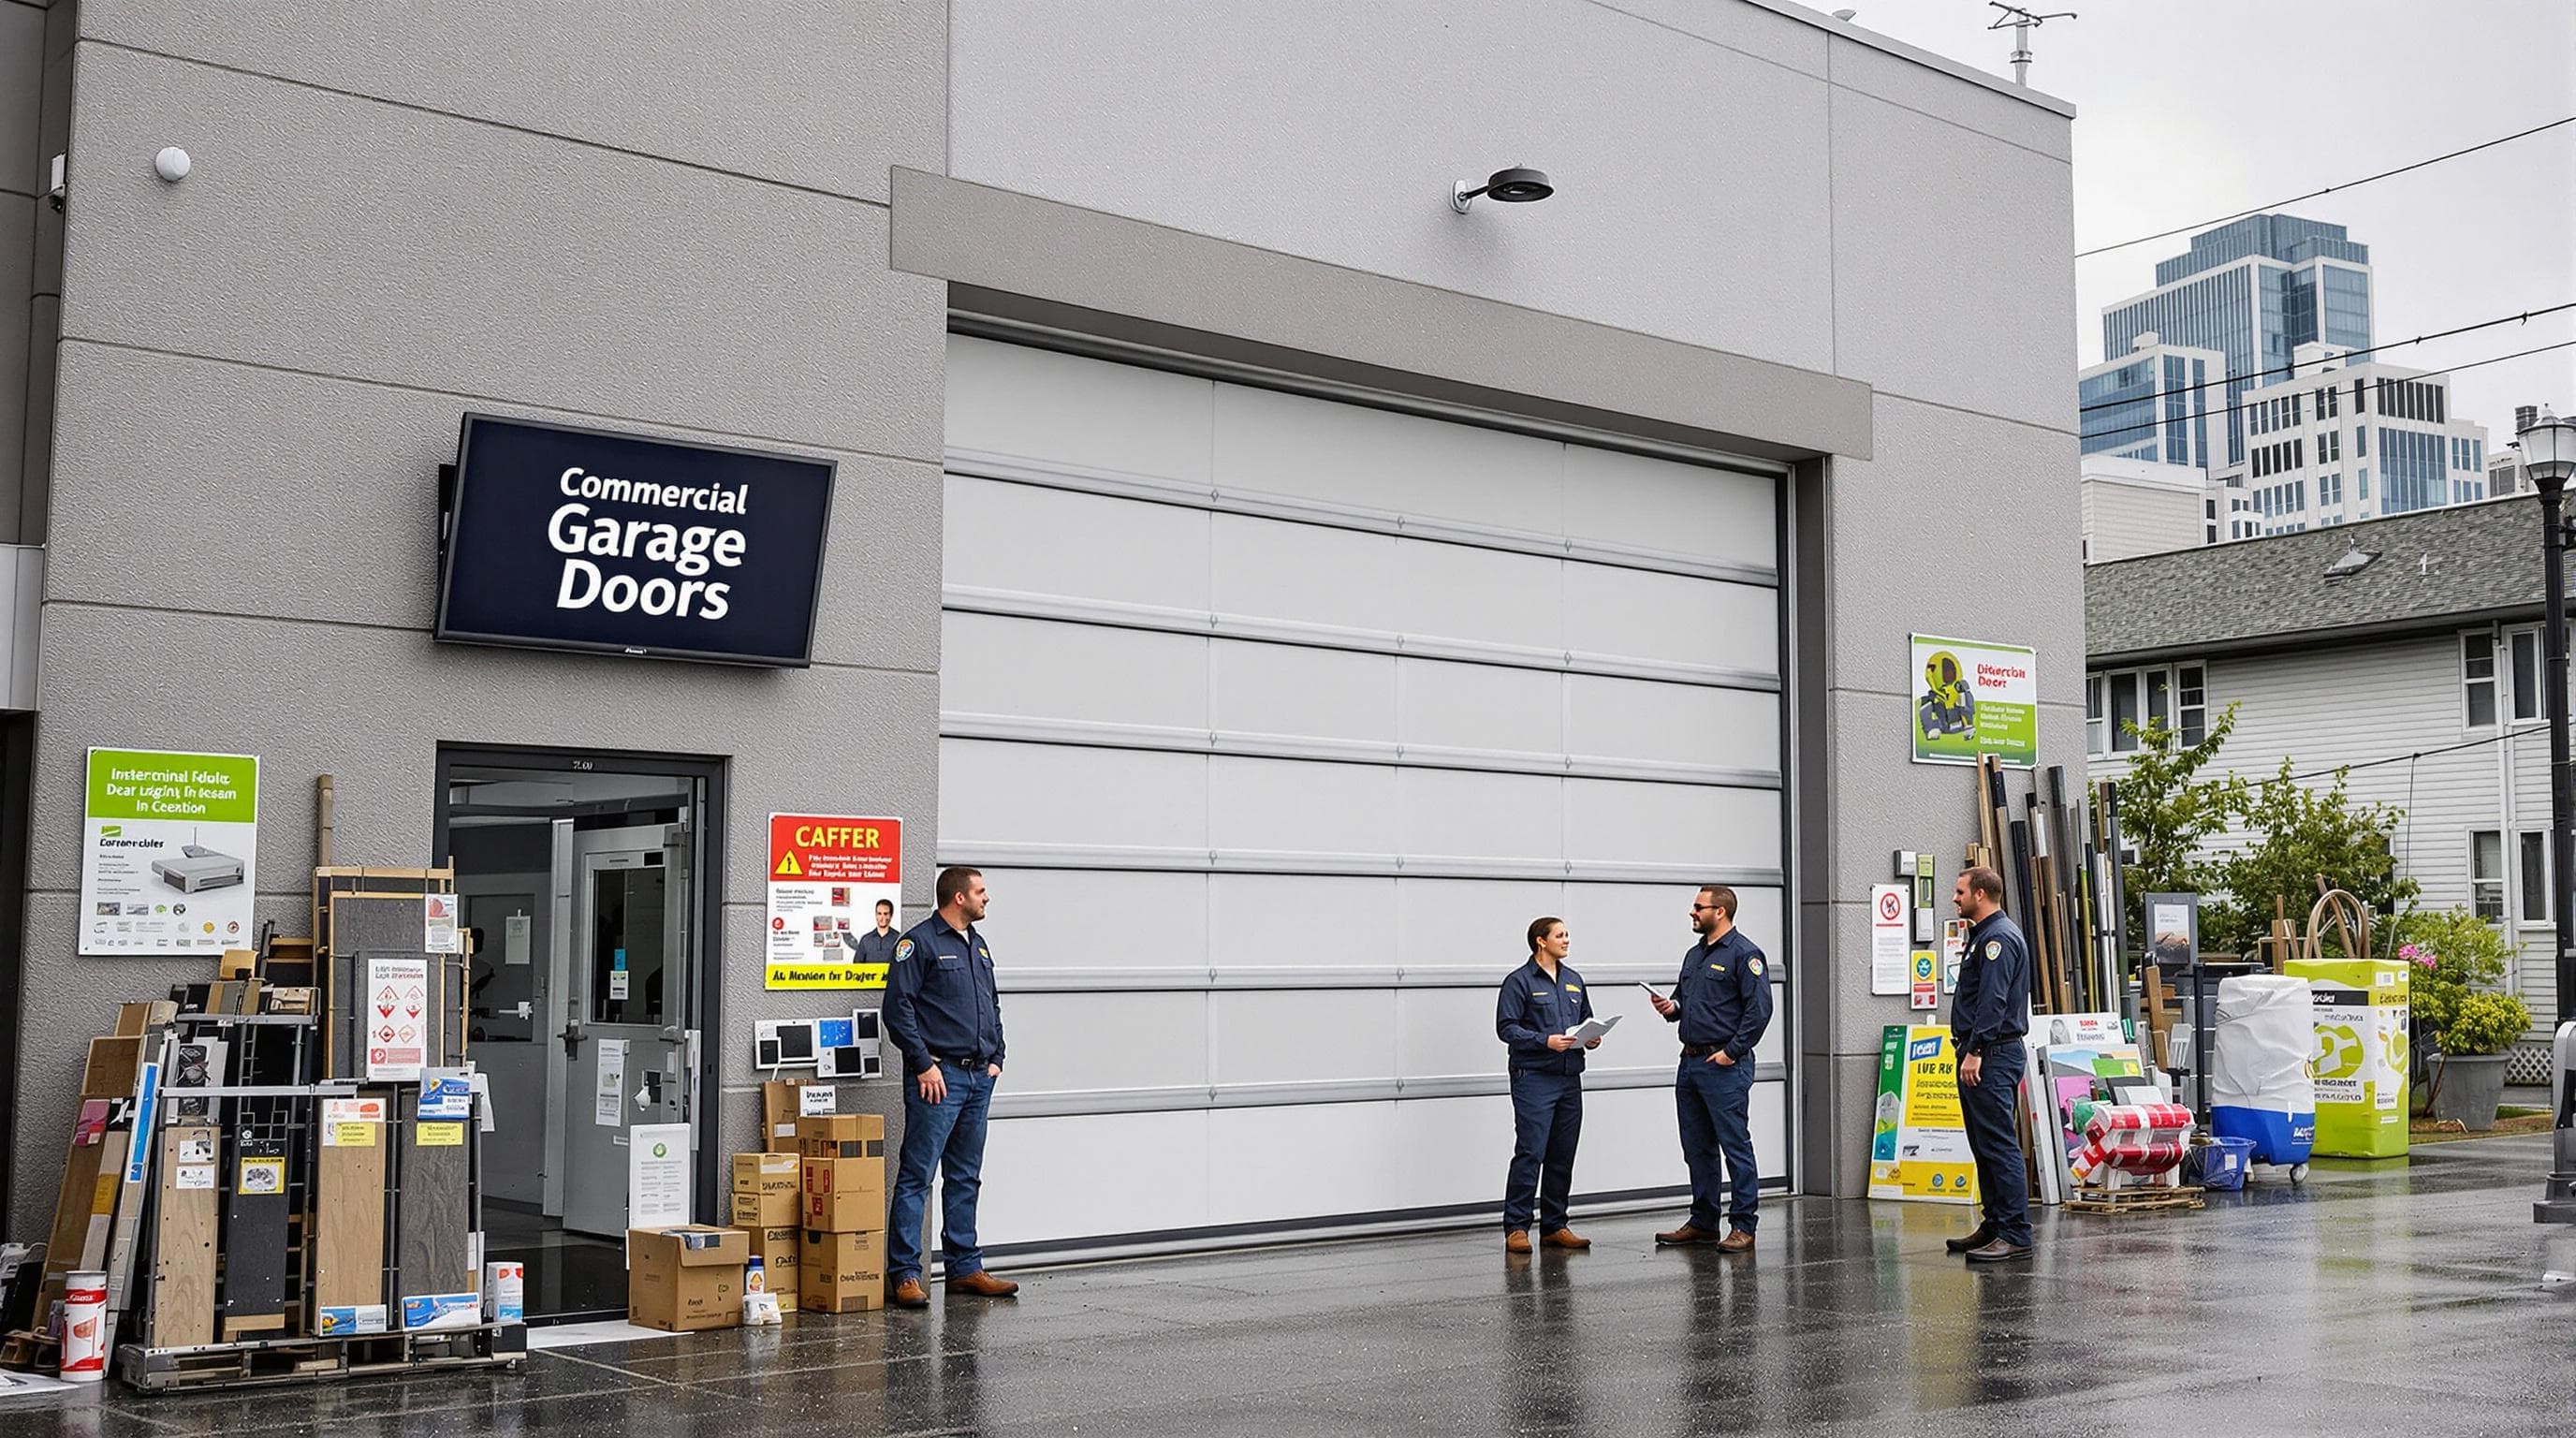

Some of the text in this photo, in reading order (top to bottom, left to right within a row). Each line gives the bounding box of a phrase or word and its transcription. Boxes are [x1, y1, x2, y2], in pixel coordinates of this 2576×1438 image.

[561, 466, 749, 515] Commercial
[548, 502, 747, 577] Garage
[556, 558, 731, 621] Doors
[136, 800, 149, 812] In
[795, 825, 881, 850] CAFFER
